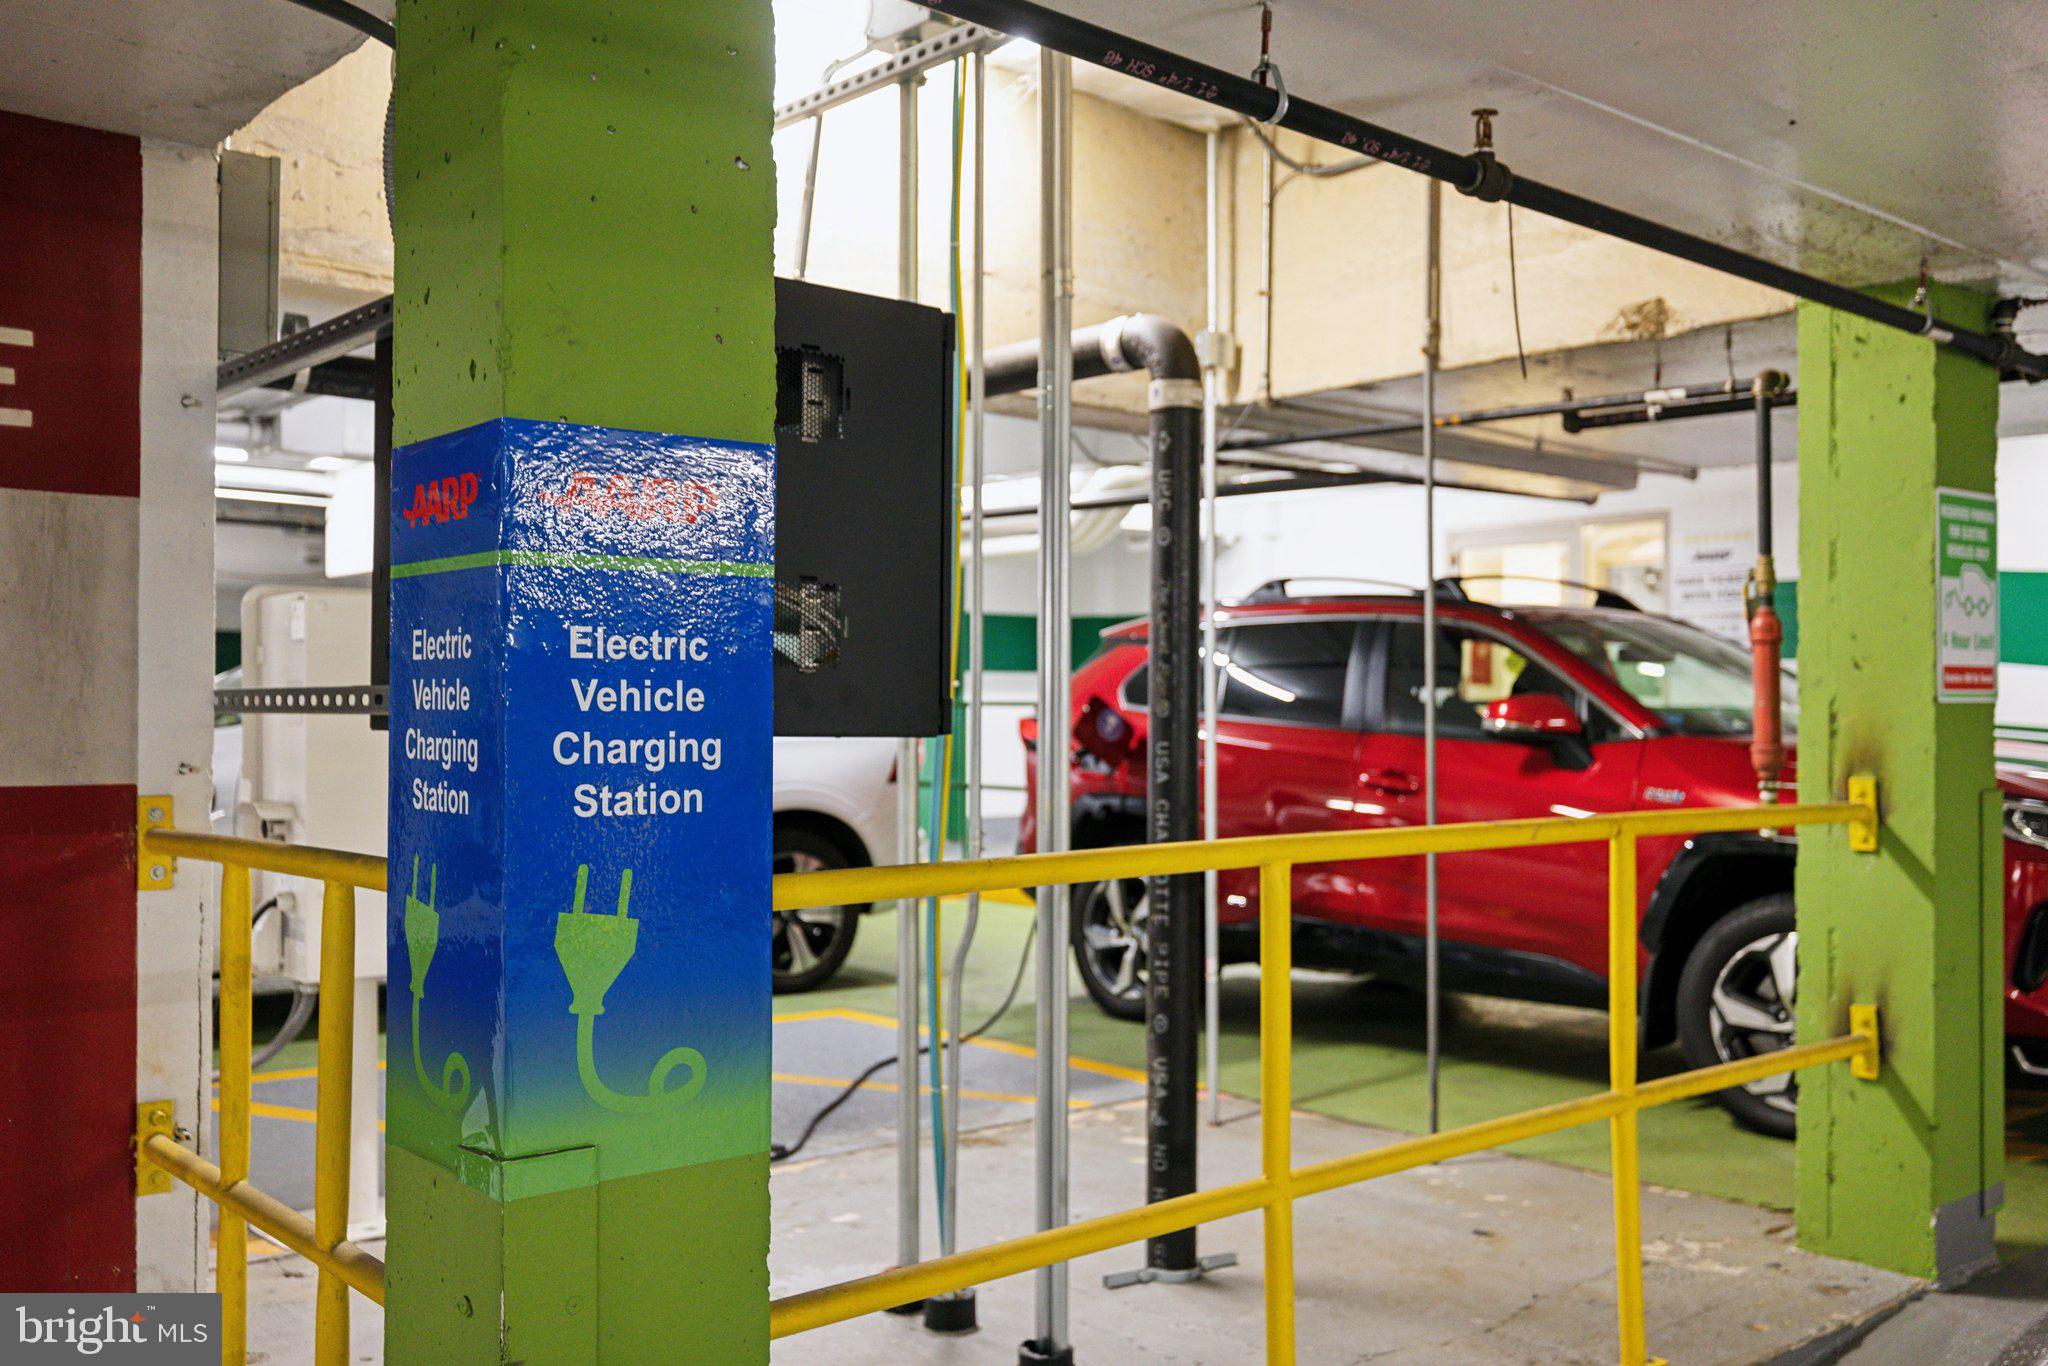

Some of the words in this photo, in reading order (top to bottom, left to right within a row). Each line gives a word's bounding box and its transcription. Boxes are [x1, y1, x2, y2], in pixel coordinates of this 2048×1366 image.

[1126, 59, 1156, 79] SCH
[404, 471, 478, 528] AARP
[412, 626, 472, 661] Electric
[569, 625, 709, 662] Electric
[413, 679, 470, 712] Vehicle
[571, 678, 705, 712] Vehicle
[405, 728, 478, 772] Charging
[553, 730, 722, 772] Charging
[1155, 740, 1170, 784] USA
[412, 778, 469, 815] Station
[573, 782, 703, 818] Station
[1151, 798, 1171, 927] CHAOTTE
[1152, 941, 1170, 1000] PIPE
